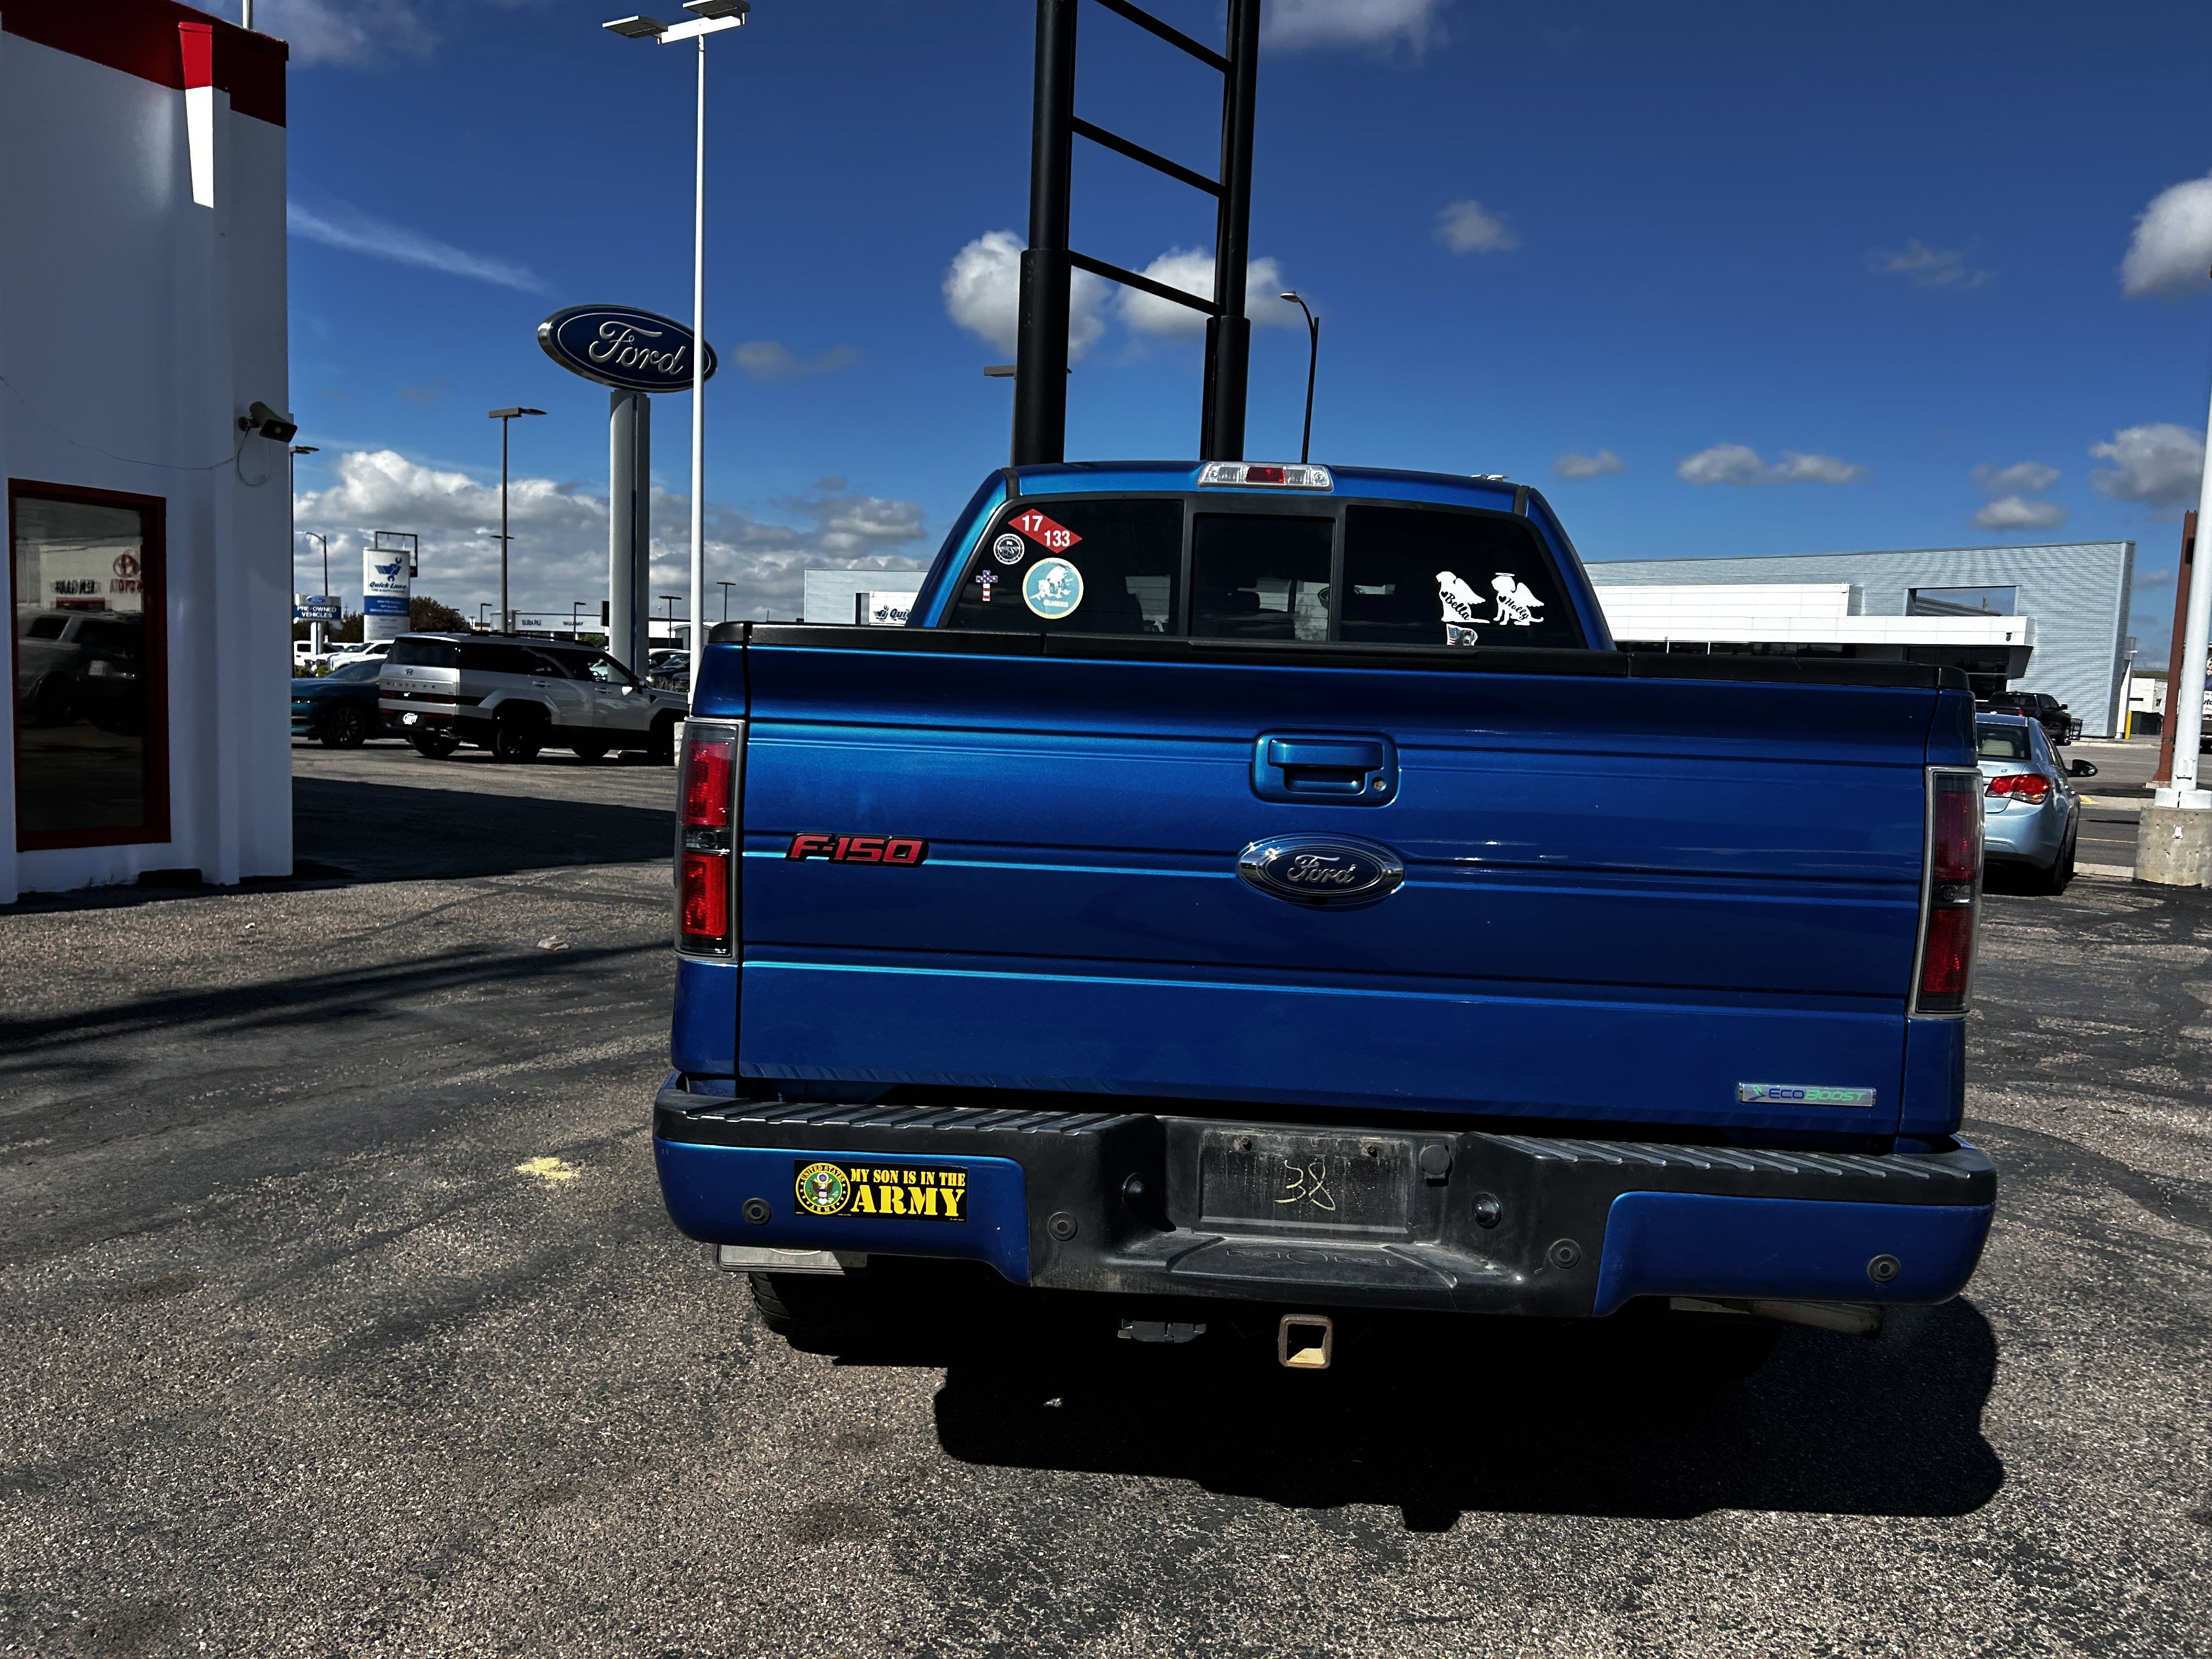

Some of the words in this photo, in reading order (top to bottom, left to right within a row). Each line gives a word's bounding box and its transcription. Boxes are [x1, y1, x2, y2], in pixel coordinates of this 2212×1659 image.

[589, 321, 686, 375] Ford
[1022, 515, 1043, 531] 17
[1044, 530, 1070, 547] 133
[889, 608, 910, 620] Qui
[1444, 592, 1470, 620] Bella
[1505, 598, 1529, 620] Holly
[789, 834, 924, 864] F-150
[1286, 854, 1358, 884] Ford
[1768, 1088, 1866, 1102] ECOBOOST
[800, 1165, 823, 1181] UNITED
[824, 1165, 847, 1182] STATES
[850, 1168, 869, 1182] MY
[873, 1169, 899, 1184] SON
[903, 1170, 916, 1184] IS
[920, 1171, 935, 1186] IN
[939, 1172, 966, 1187] THE
[809, 1204, 837, 1212] ARMY
[850, 1184, 966, 1217] ARMY
